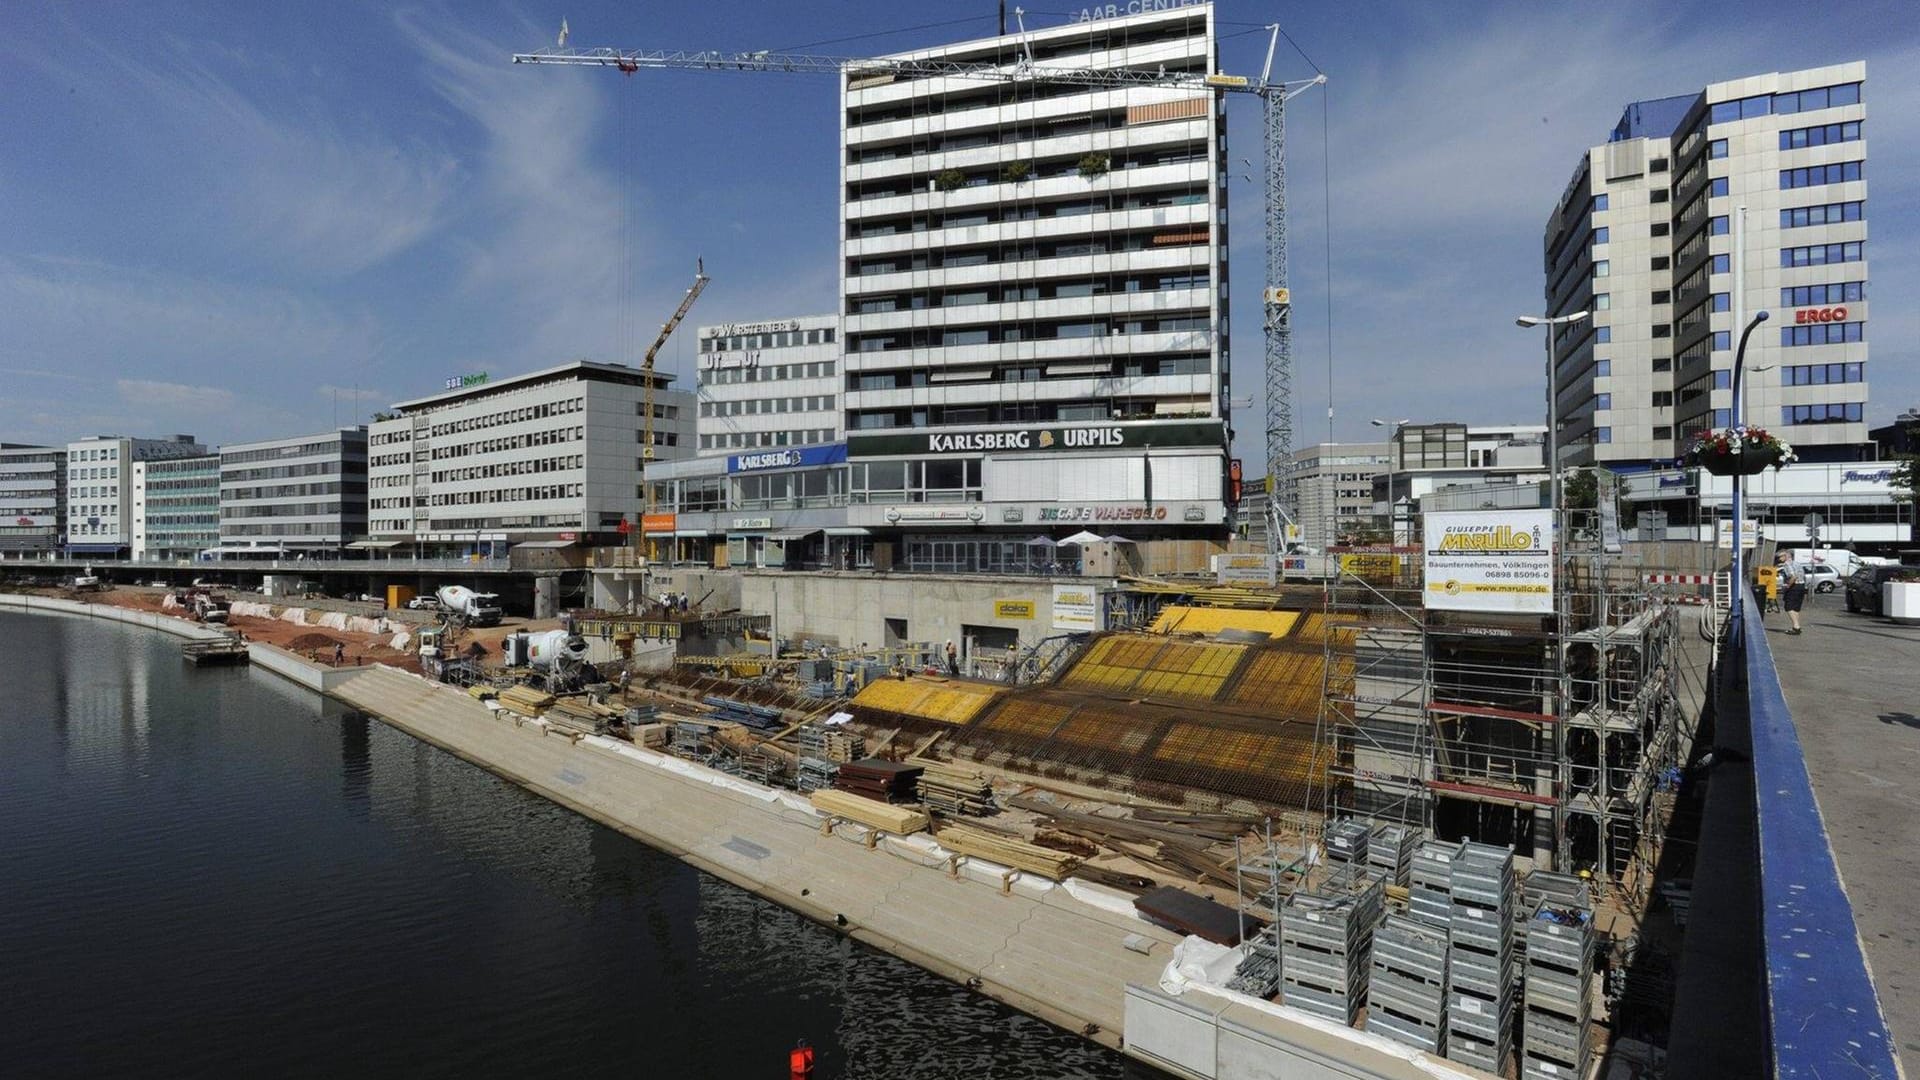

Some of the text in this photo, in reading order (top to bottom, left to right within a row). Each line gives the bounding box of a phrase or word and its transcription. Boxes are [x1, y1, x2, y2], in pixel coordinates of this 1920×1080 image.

[1796, 307, 1847, 324] ERGO
[718, 321, 786, 337] WARSTEINER
[929, 428, 1125, 452] KARLSBERG URPILS
[738, 450, 790, 471] KARLSBERG
[1428, 561, 1549, 570] Bauunternehmen, Völklingen
[1475, 585, 1547, 594] www.marullo.de
[1000, 603, 1029, 612] doka
